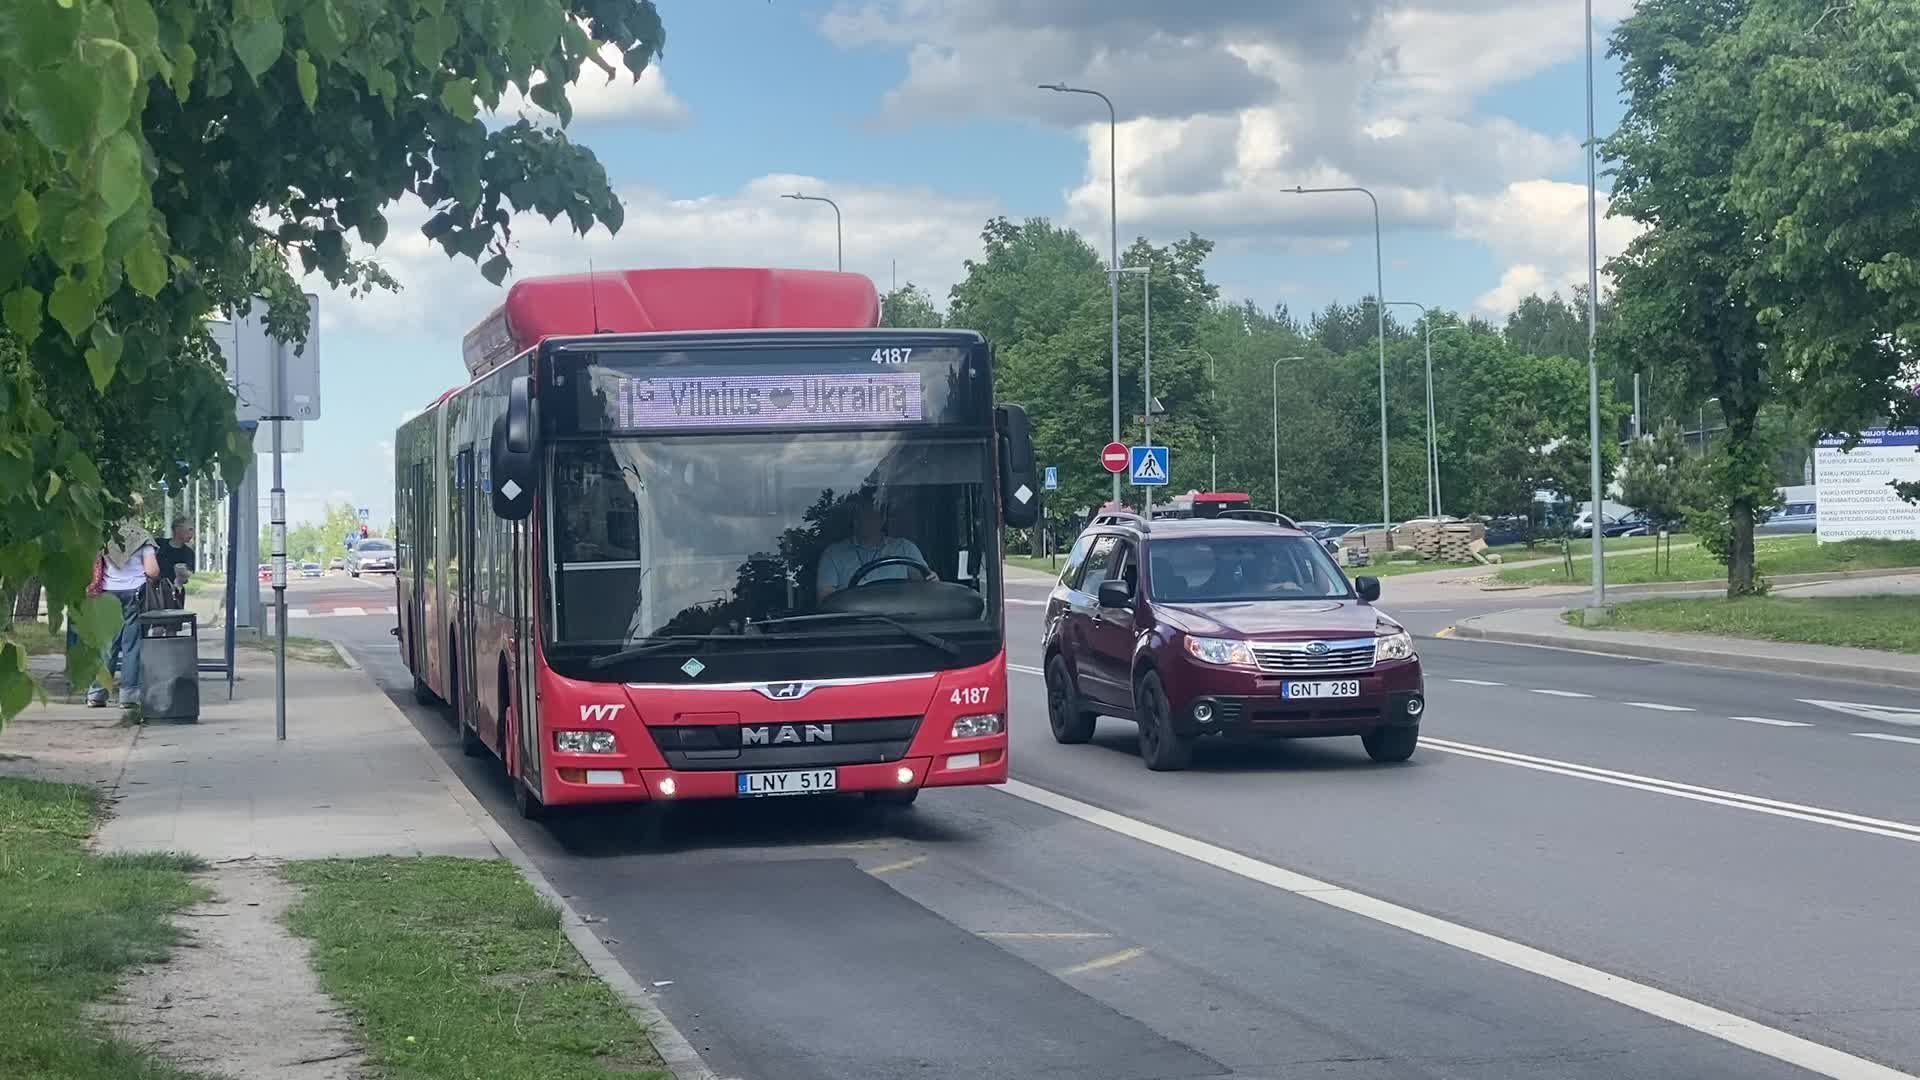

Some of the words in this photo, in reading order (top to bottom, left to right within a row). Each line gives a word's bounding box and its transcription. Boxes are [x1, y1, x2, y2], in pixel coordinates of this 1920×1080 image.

[871, 348, 912, 364] 4187
[669, 381, 761, 416] Vilnius
[803, 377, 909, 418] Ukrainą
[950, 687, 990, 705] 4187
[1291, 683, 1322, 696] GNT
[1331, 682, 1357, 696] 289
[580, 704, 626, 721] VVT
[741, 724, 833, 745] MAN
[750, 774, 788, 791] LNY
[800, 772, 833, 788] 512
